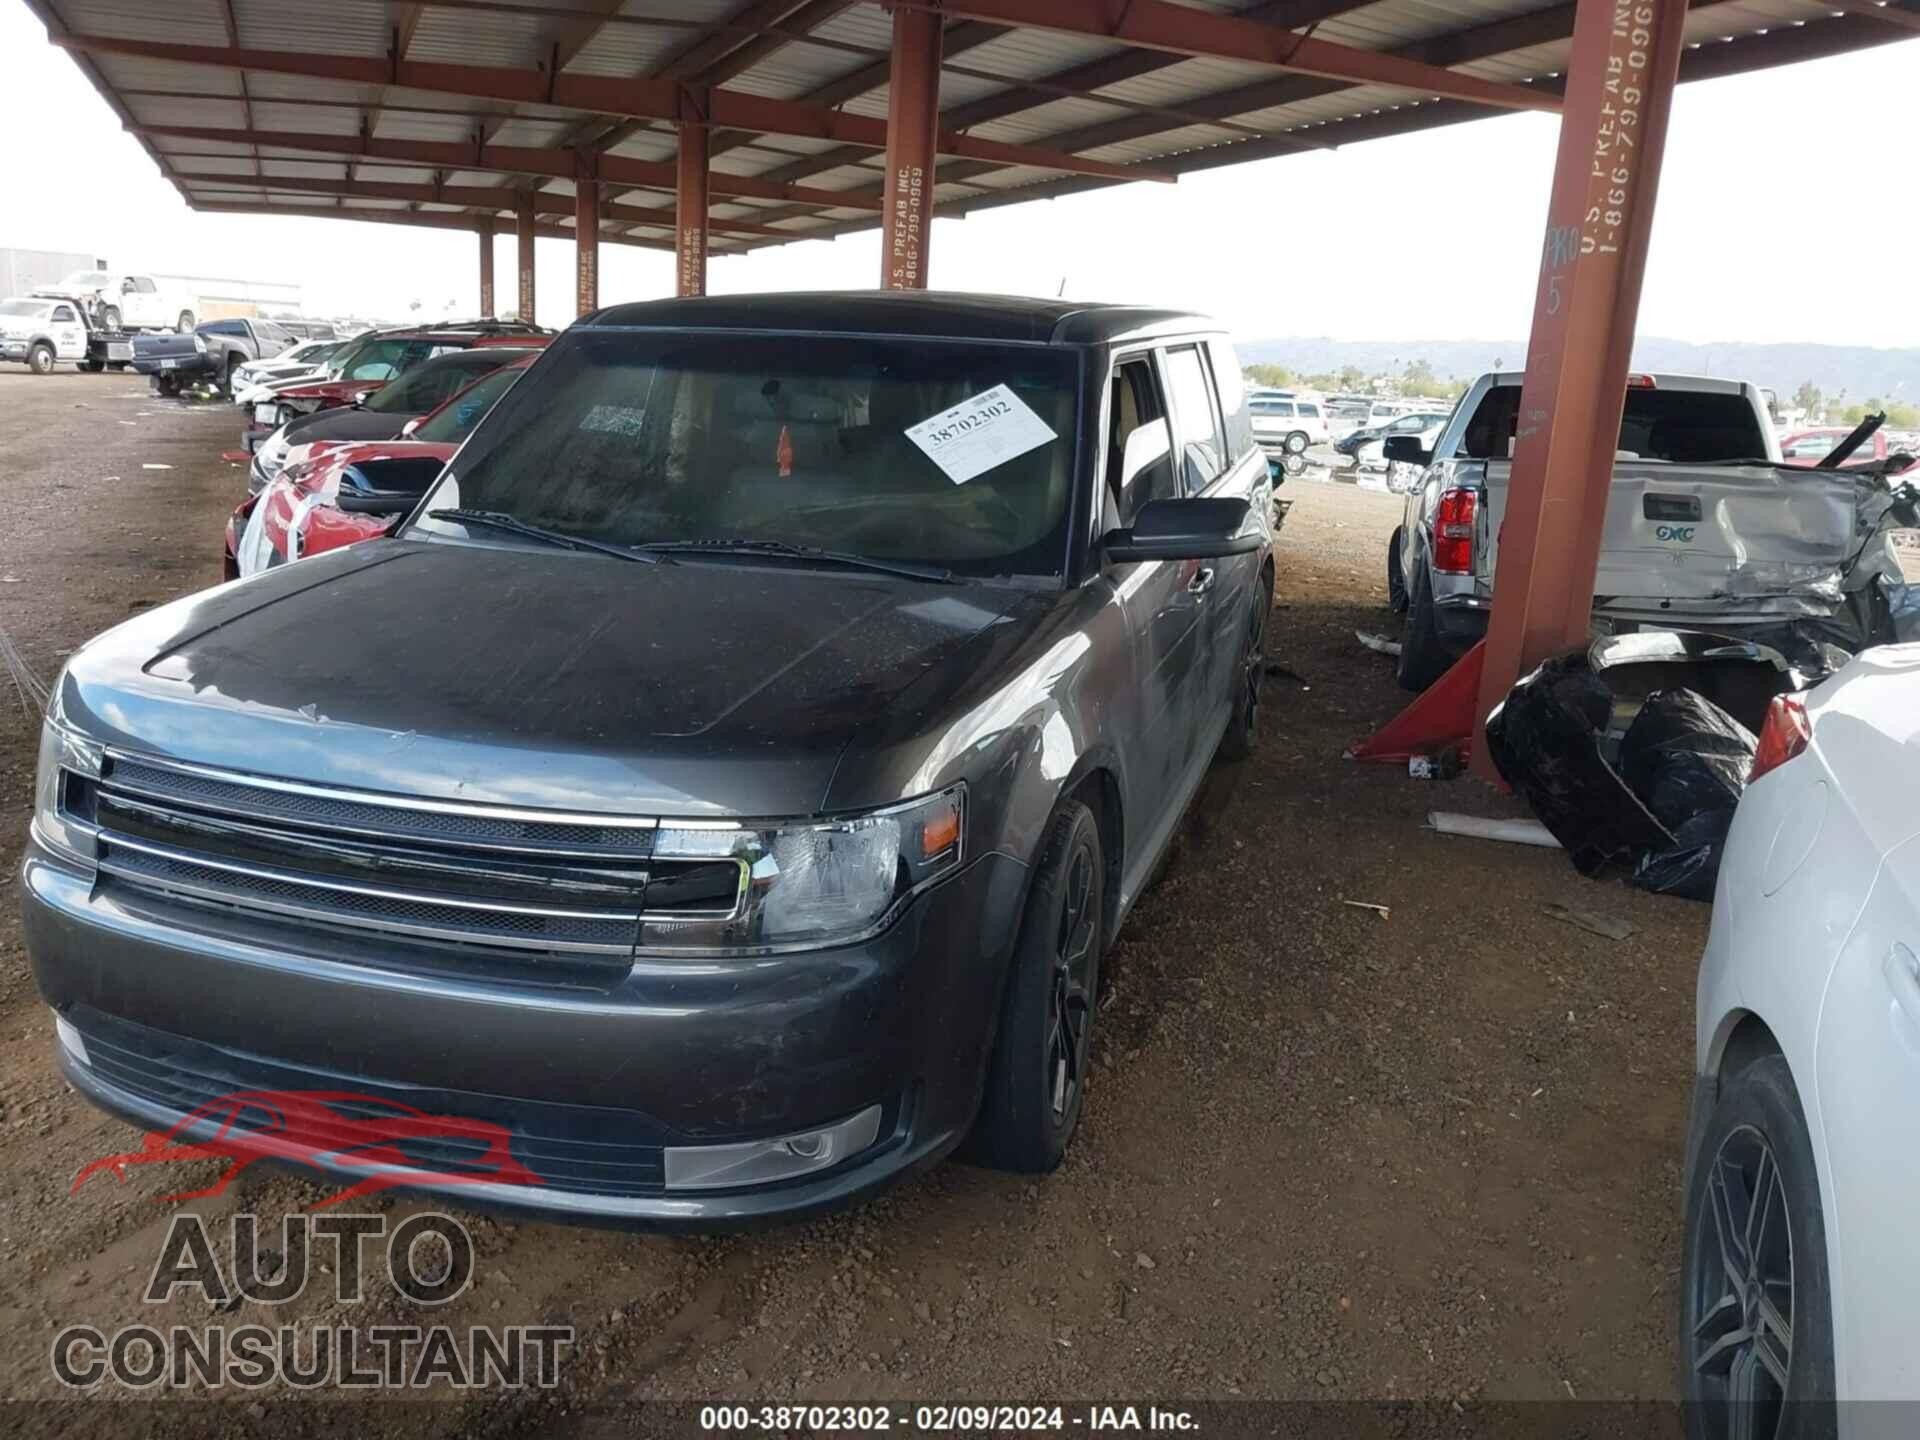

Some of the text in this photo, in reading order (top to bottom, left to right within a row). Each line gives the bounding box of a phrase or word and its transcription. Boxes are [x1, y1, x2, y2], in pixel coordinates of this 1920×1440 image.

[1592, 55, 1624, 177] PREFAB
[1599, 0, 1654, 254] 1-866-799-096
[897, 164, 911, 193] INC.
[894, 200, 909, 257] PREFAB
[905, 167, 923, 290] -866-799-0969
[1547, 275, 1566, 315] 5
[928, 400, 1012, 447] 38702302
